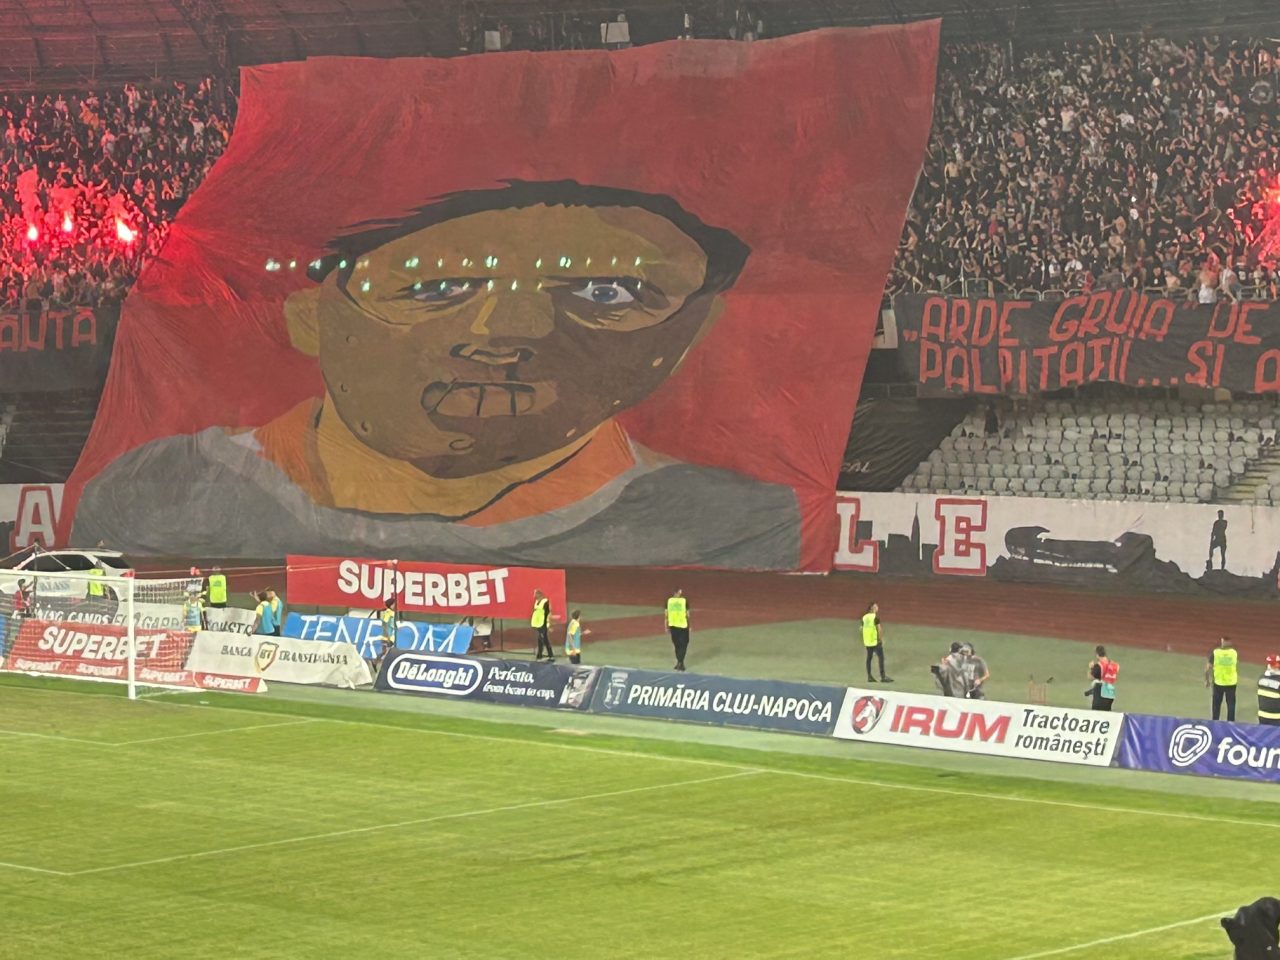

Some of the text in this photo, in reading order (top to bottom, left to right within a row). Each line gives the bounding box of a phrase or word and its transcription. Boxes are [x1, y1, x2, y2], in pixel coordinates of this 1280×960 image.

[1207, 301, 1270, 345] DE
[336, 559, 510, 607] SUPERBET
[37, 626, 168, 661] SUPERBET
[221, 645, 253, 657] BANCA
[202, 675, 251, 690] SUPERBET
[627, 683, 833, 723] PRIMĂRIA CLUJ-NAPOCA
[1022, 708, 1111, 735] Tractoare
[889, 705, 1013, 744] IRUM
